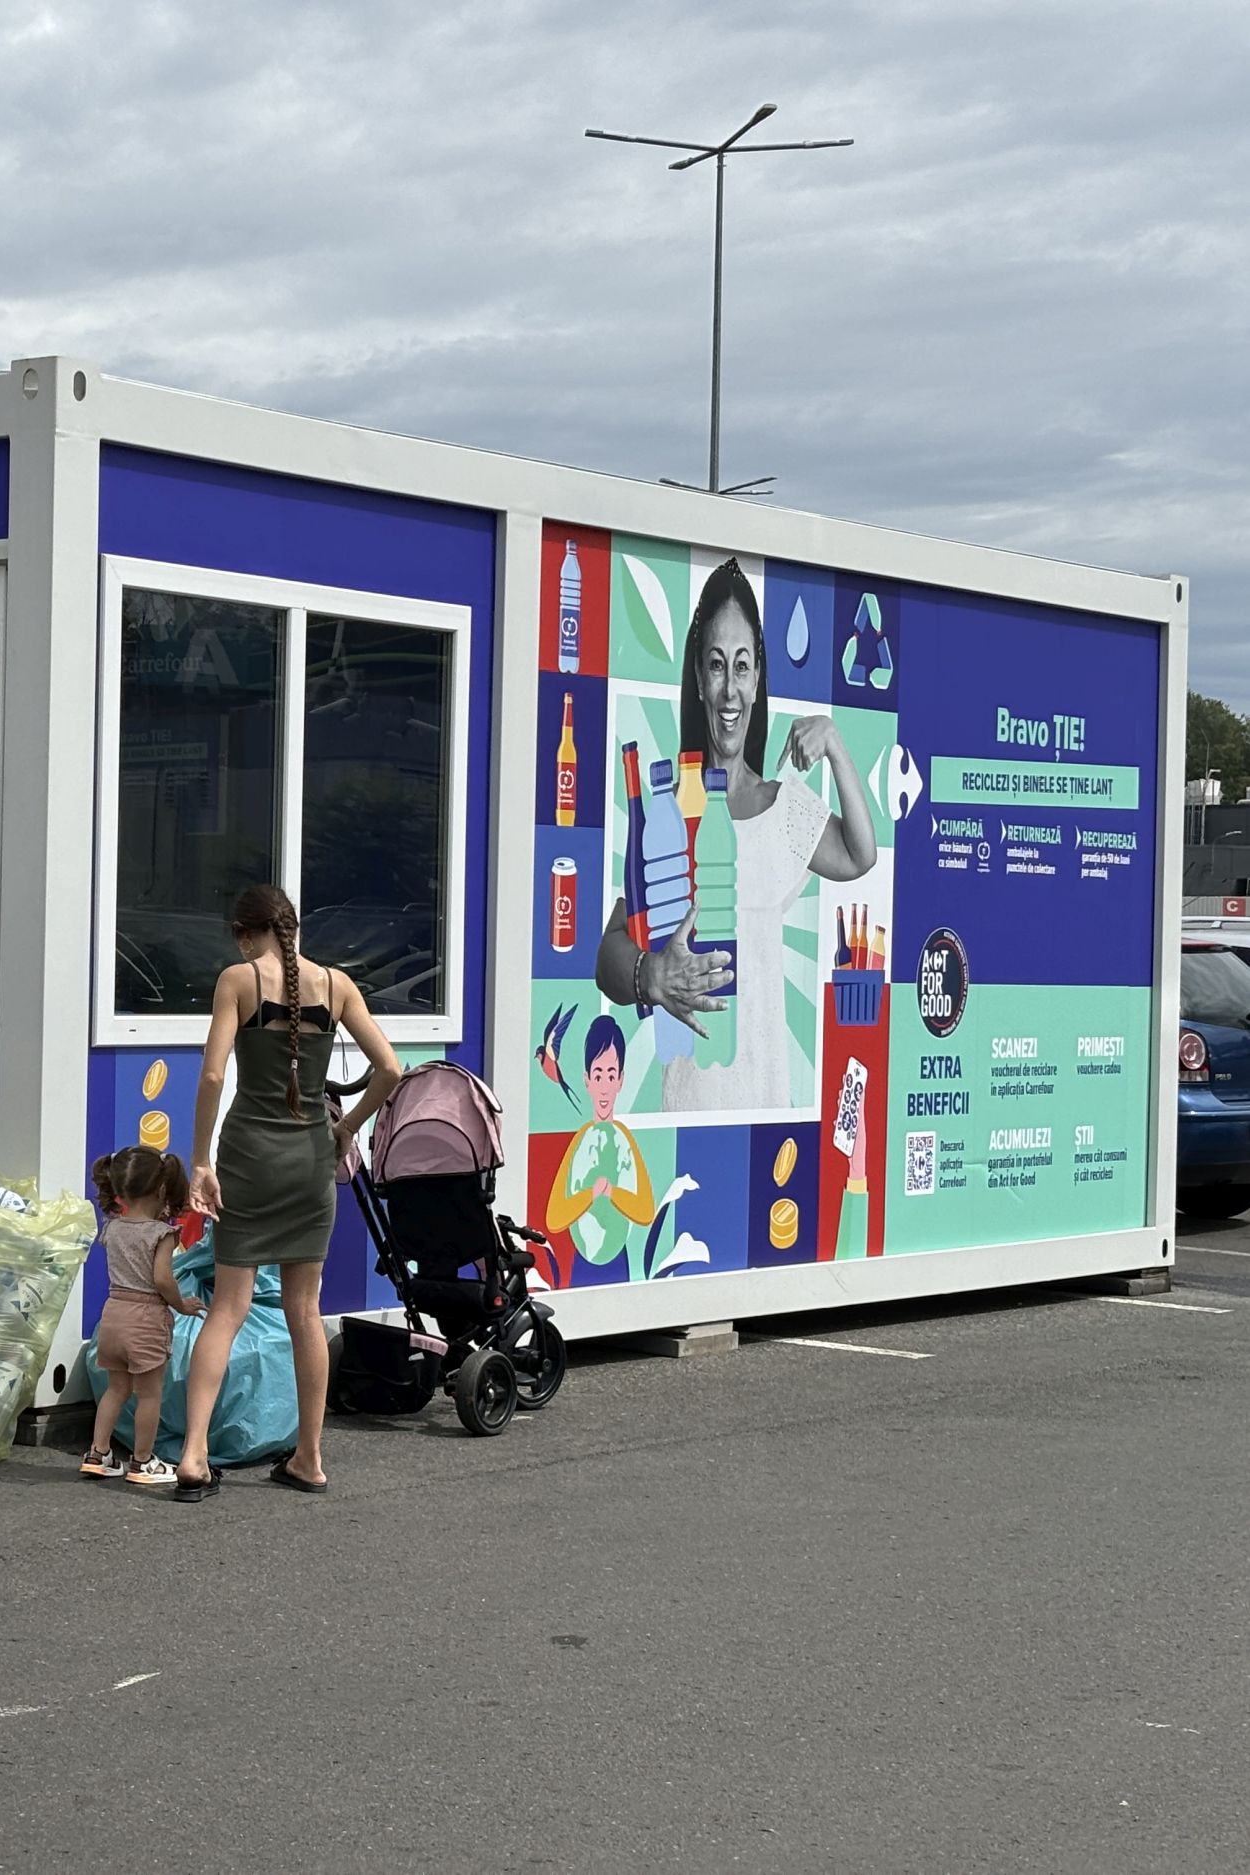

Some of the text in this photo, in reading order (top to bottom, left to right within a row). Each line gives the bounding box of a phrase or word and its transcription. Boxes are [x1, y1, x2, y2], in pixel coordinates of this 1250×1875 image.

[996, 707, 1086, 762] Bravo ȚIE!
[962, 772, 1114, 802] RECICLEZI ȘI BINELE SE ȚINE LANȚ
[939, 818, 984, 838] CUMPĂRĂ
[1007, 824, 1062, 844] RETURNEAZĂ
[1082, 830, 1137, 850] RECUPEREAZĂ
[1226, 900, 1239, 912] C
[921, 972, 943, 995] FOR
[920, 994, 952, 1018] GOOD
[991, 1037, 1038, 1059] SCANEZI
[1077, 1036, 1124, 1063] PRIMEȘTI
[920, 1056, 962, 1079] EXTRA
[991, 1062, 1057, 1077] voucherul de reciclare
[1077, 1062, 1121, 1075] vouchere cadou
[1026, 1081, 1054, 1095] Carrefour
[908, 1092, 970, 1116] BENEFICII
[989, 1127, 1052, 1150] ACUMULEZI
[1020, 1172, 1036, 1186] Good
